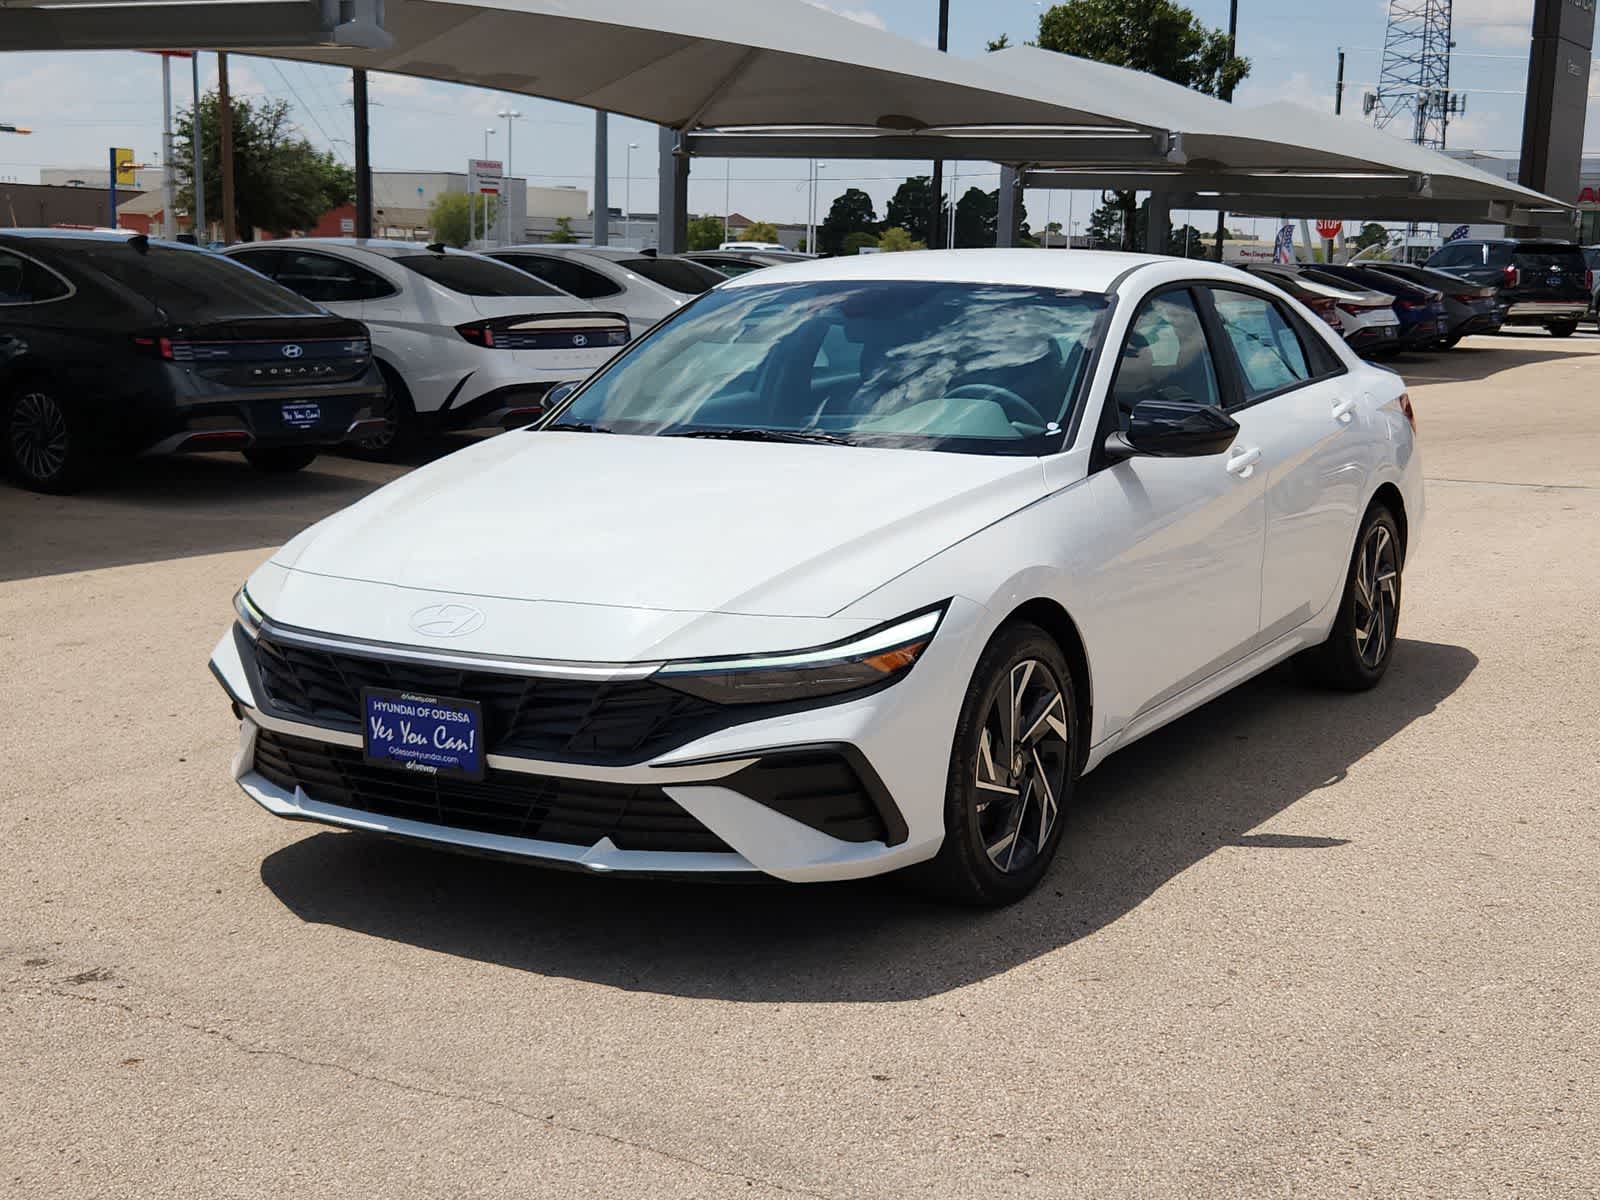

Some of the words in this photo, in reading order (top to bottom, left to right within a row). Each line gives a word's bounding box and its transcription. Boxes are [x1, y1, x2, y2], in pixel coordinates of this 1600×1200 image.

[1317, 219, 1340, 230] STOP
[254, 366, 335, 375] SONATA
[374, 701, 416, 716] HYUNDAI
[417, 707, 431, 718] OF
[431, 709, 470, 723] ODESSA
[370, 716, 394, 741] Yes
[400, 720, 428, 744] You
[434, 725, 474, 753] Can!
